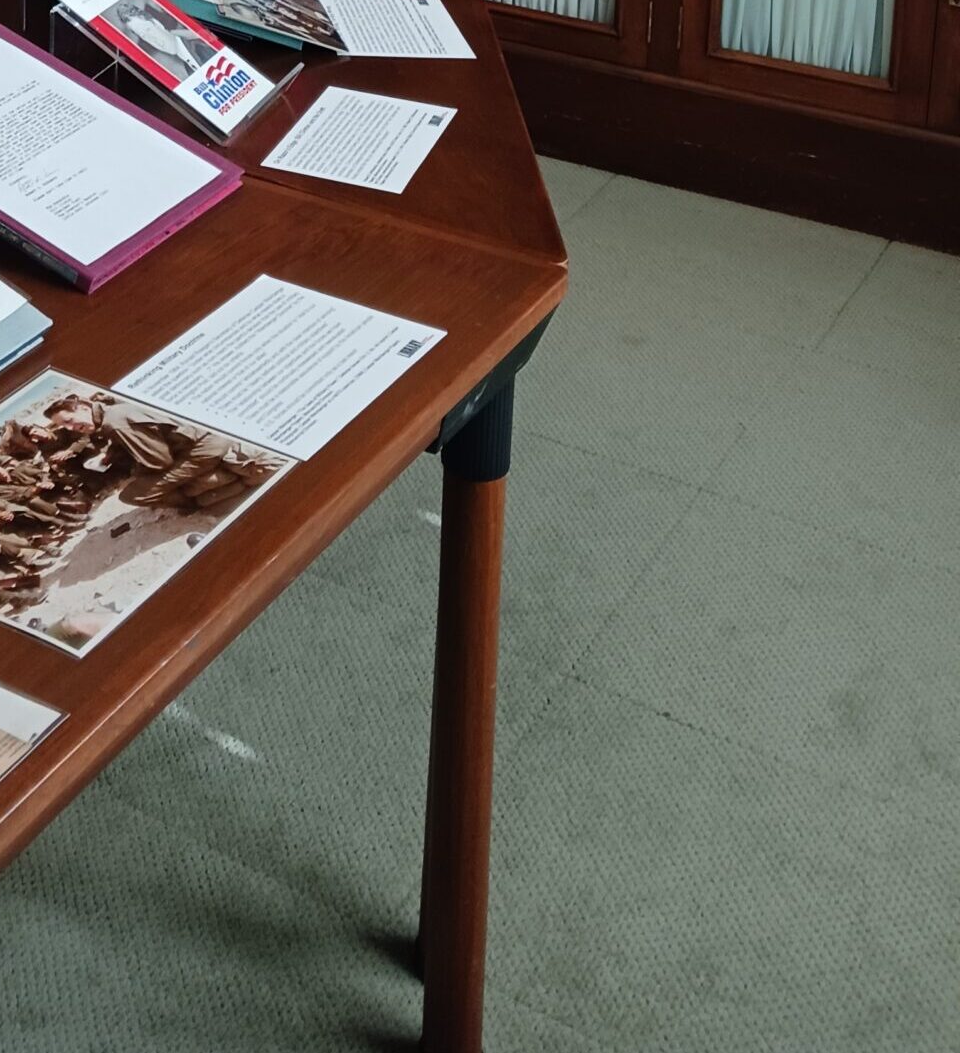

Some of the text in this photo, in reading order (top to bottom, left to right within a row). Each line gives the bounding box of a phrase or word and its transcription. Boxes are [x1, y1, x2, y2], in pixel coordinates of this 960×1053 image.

[193, 81, 209, 96] Bill
[202, 69, 251, 109] Clinton
[218, 79, 258, 116] FOR PRESIDENT
